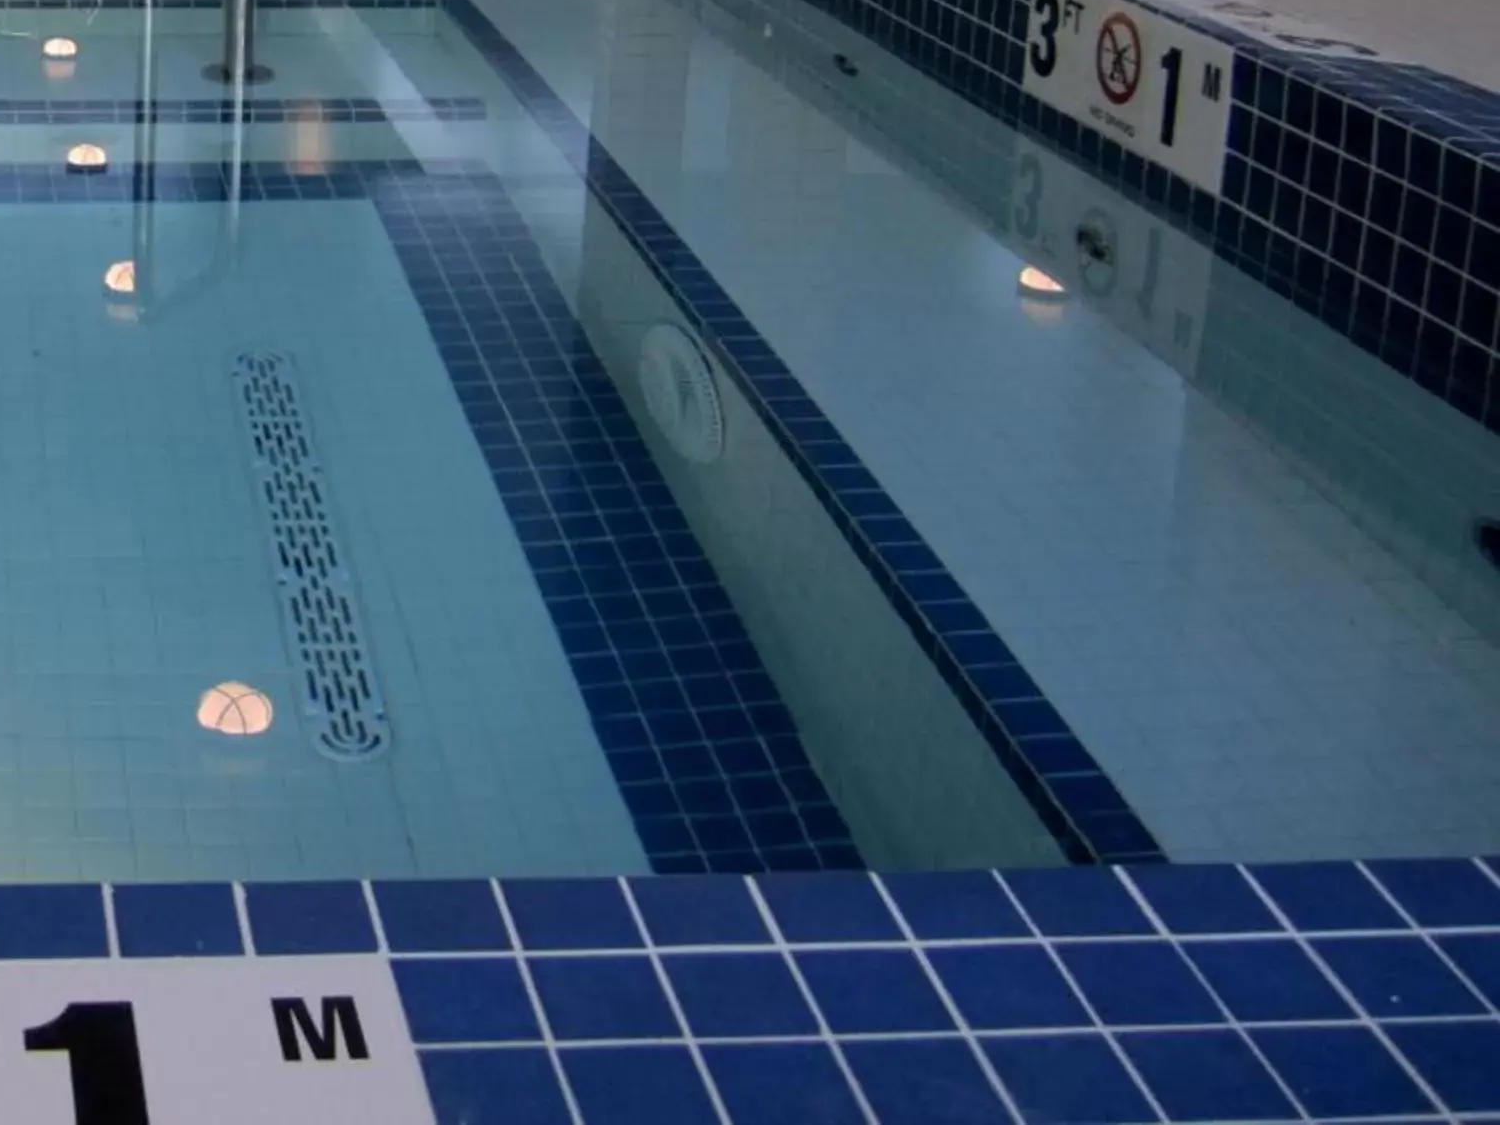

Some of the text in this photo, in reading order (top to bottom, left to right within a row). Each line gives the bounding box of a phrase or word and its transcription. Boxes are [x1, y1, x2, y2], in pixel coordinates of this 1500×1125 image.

[1161, 46, 1182, 148] 1
[1202, 61, 1222, 103] M
[23, 1001, 150, 1125] 1
[271, 996, 370, 1062] M
